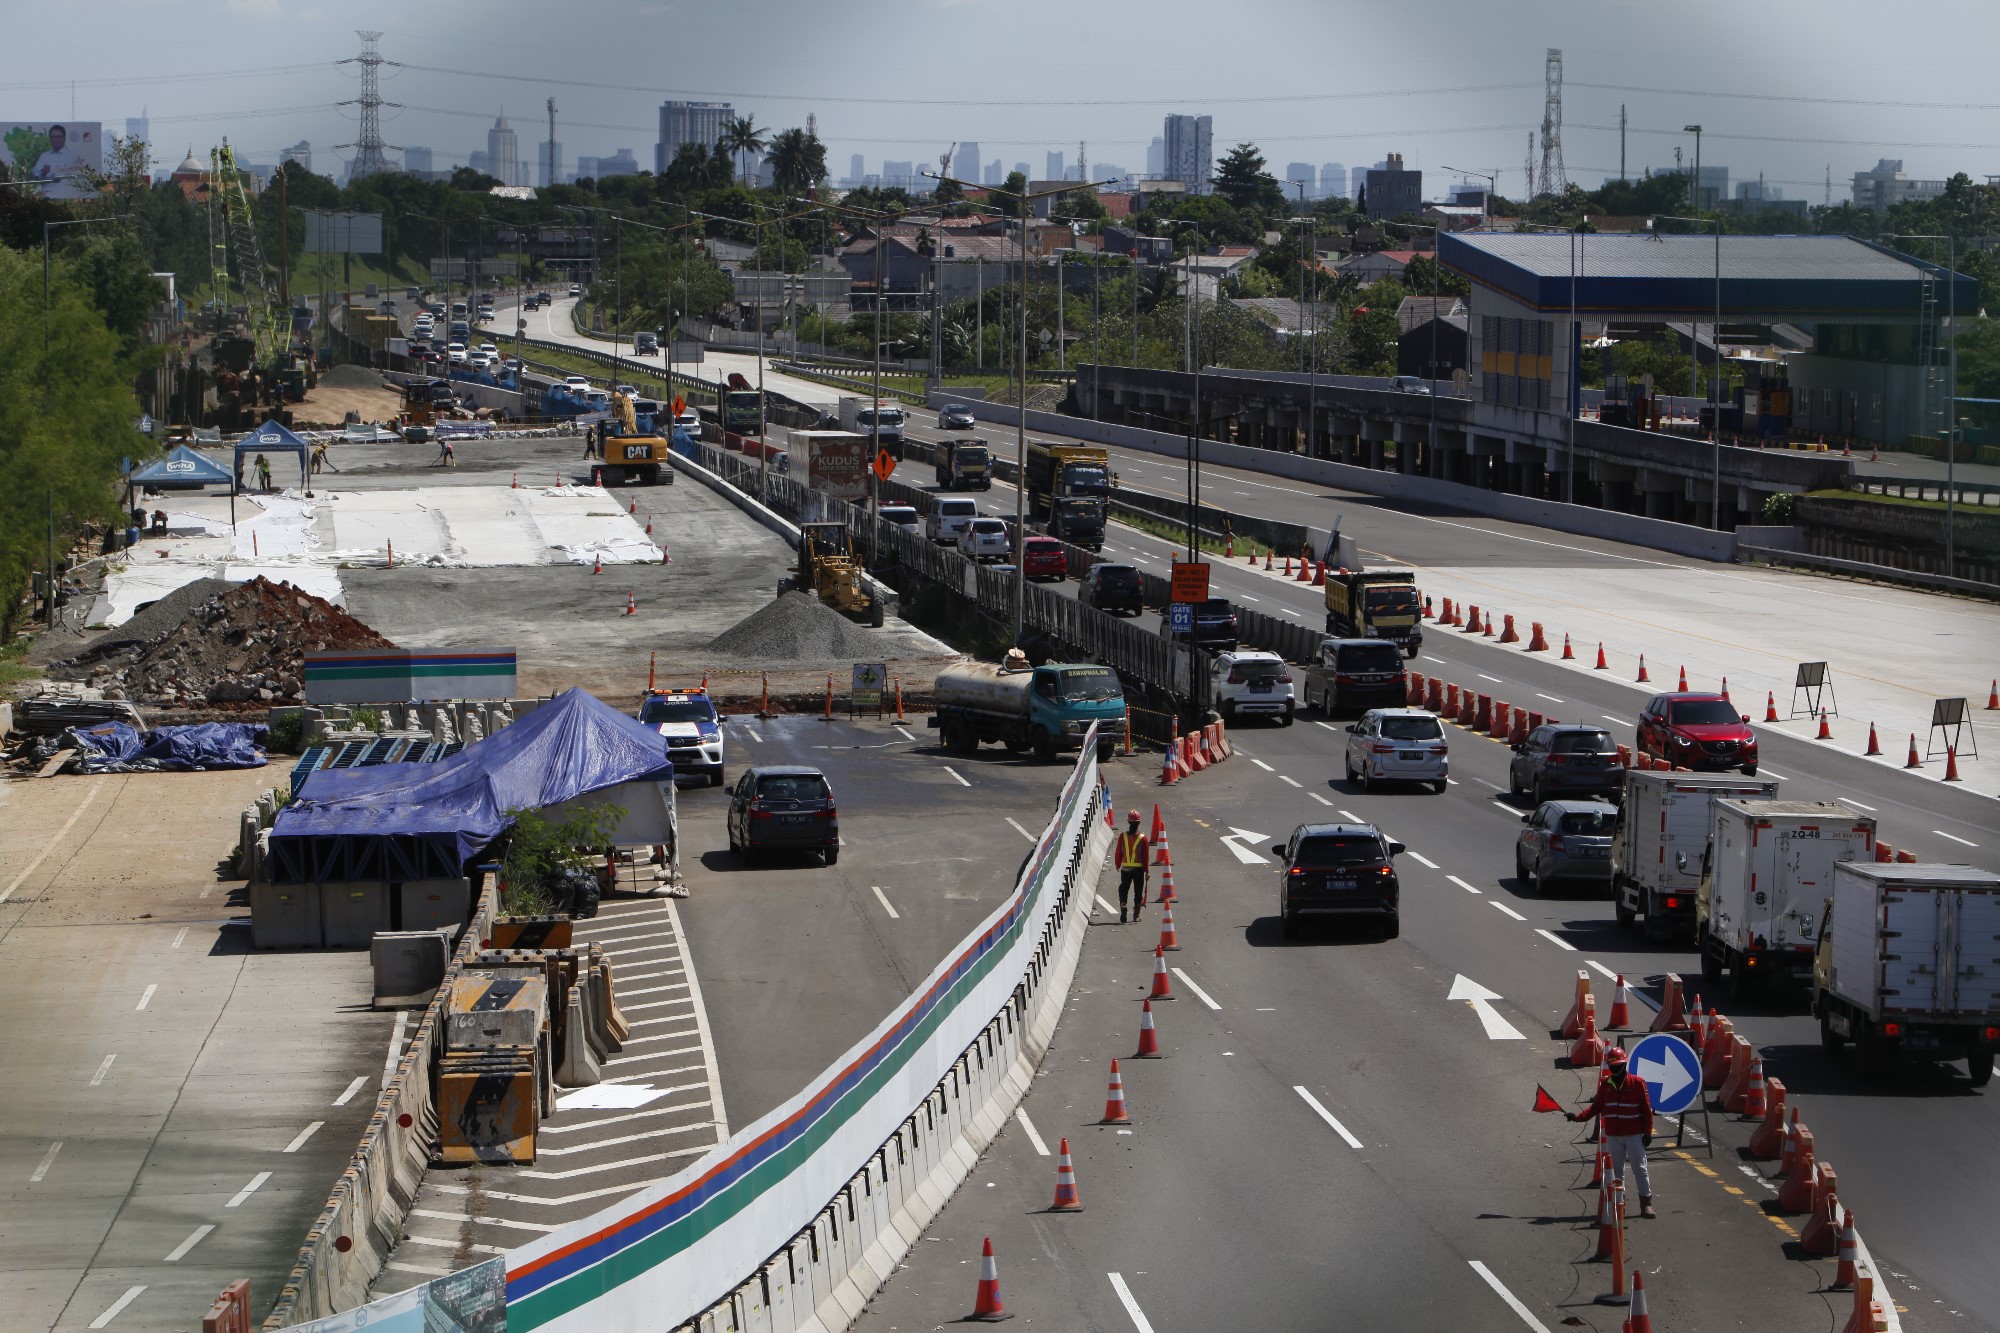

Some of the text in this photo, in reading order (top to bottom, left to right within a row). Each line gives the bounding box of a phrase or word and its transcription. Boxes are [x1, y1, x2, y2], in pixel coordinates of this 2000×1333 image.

[628, 446, 648, 459] CAT
[818, 456, 860, 466] KUDUS
[1174, 613, 1188, 624] 01
[1791, 830, 1821, 839] ZQ-48
[455, 1016, 476, 1028] 160
